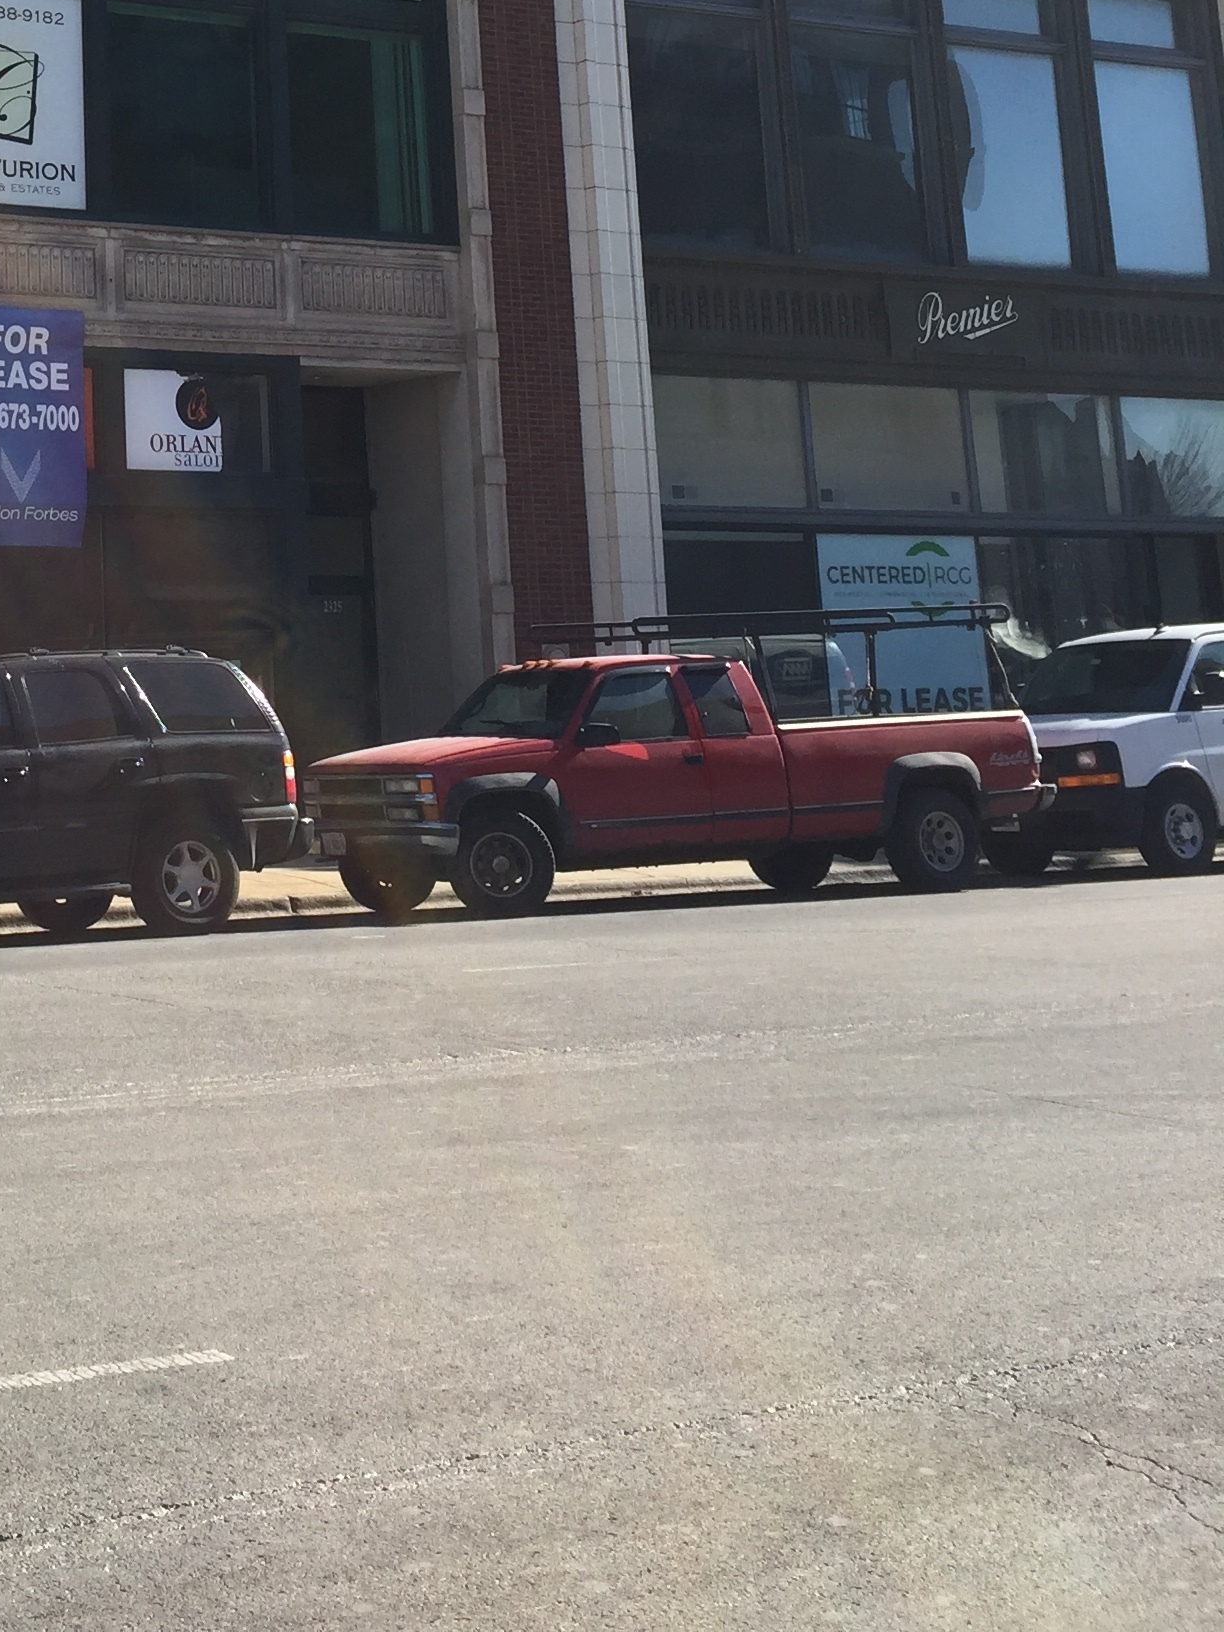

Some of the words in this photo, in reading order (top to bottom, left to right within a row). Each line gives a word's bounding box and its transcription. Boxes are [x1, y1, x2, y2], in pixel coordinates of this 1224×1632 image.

[11, 183, 61, 196] ESTATES
[918, 291, 1018, 344] Premier
[150, 433, 222, 454] ORLAN
[24, 506, 78, 522] Forbes
[837, 688, 893, 716] FOR
[901, 687, 985, 714] LEASE
